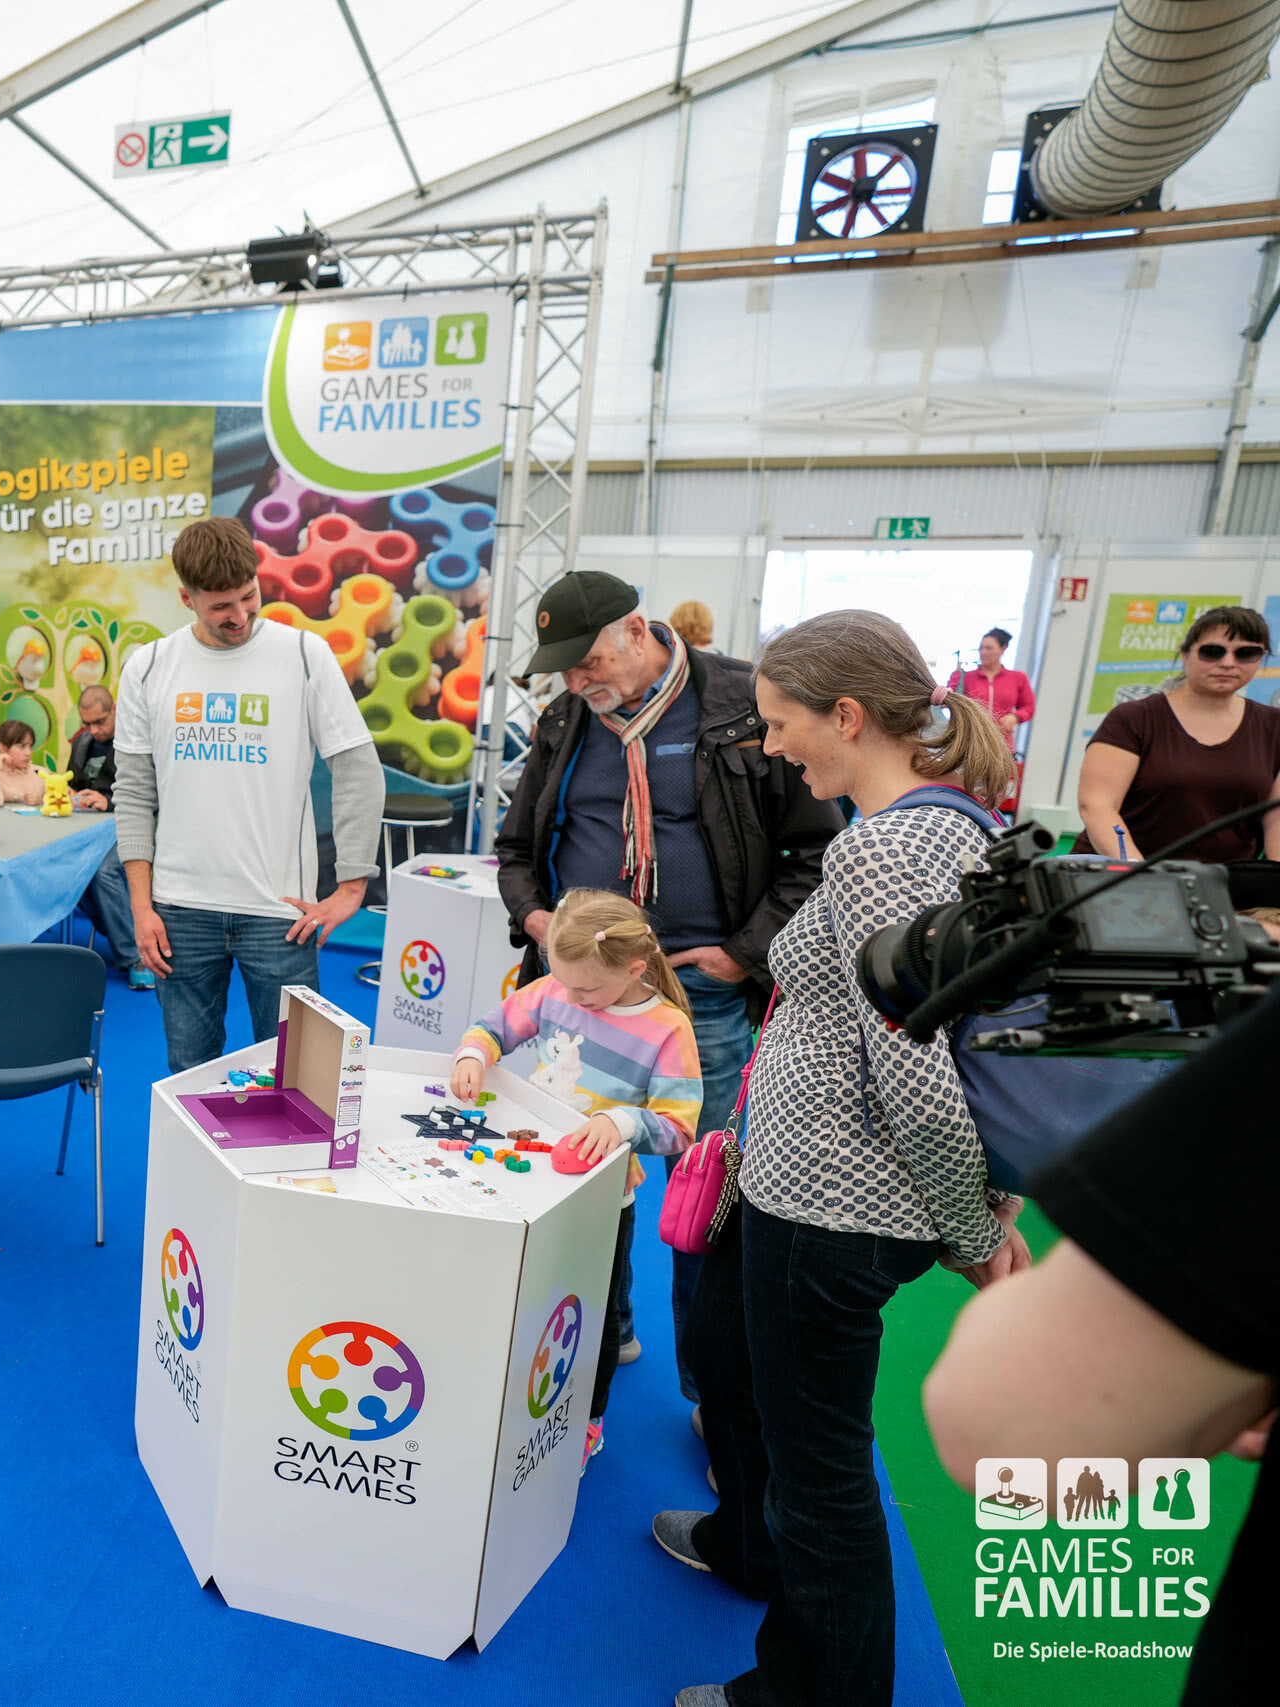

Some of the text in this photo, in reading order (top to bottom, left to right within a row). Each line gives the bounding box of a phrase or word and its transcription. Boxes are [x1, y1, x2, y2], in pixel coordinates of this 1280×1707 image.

[320, 373, 473, 402] GAMES FOR
[319, 398, 481, 432] FAMILIES
[42, 496, 93, 529] die
[100, 492, 207, 529] ganze
[1120, 636, 1177, 649] FAMIL
[175, 726, 262, 742] GAMES FOR
[174, 743, 268, 764] FAMILIES
[392, 1007, 442, 1035] GAMES
[394, 996, 443, 1022] SMART
[157, 1320, 201, 1400] SMART
[155, 1341, 199, 1423] GAMES
[516, 1394, 573, 1470] SMART
[277, 1437, 421, 1481] SMART
[513, 1419, 568, 1491] GAMES
[274, 1461, 416, 1504] GAMES
